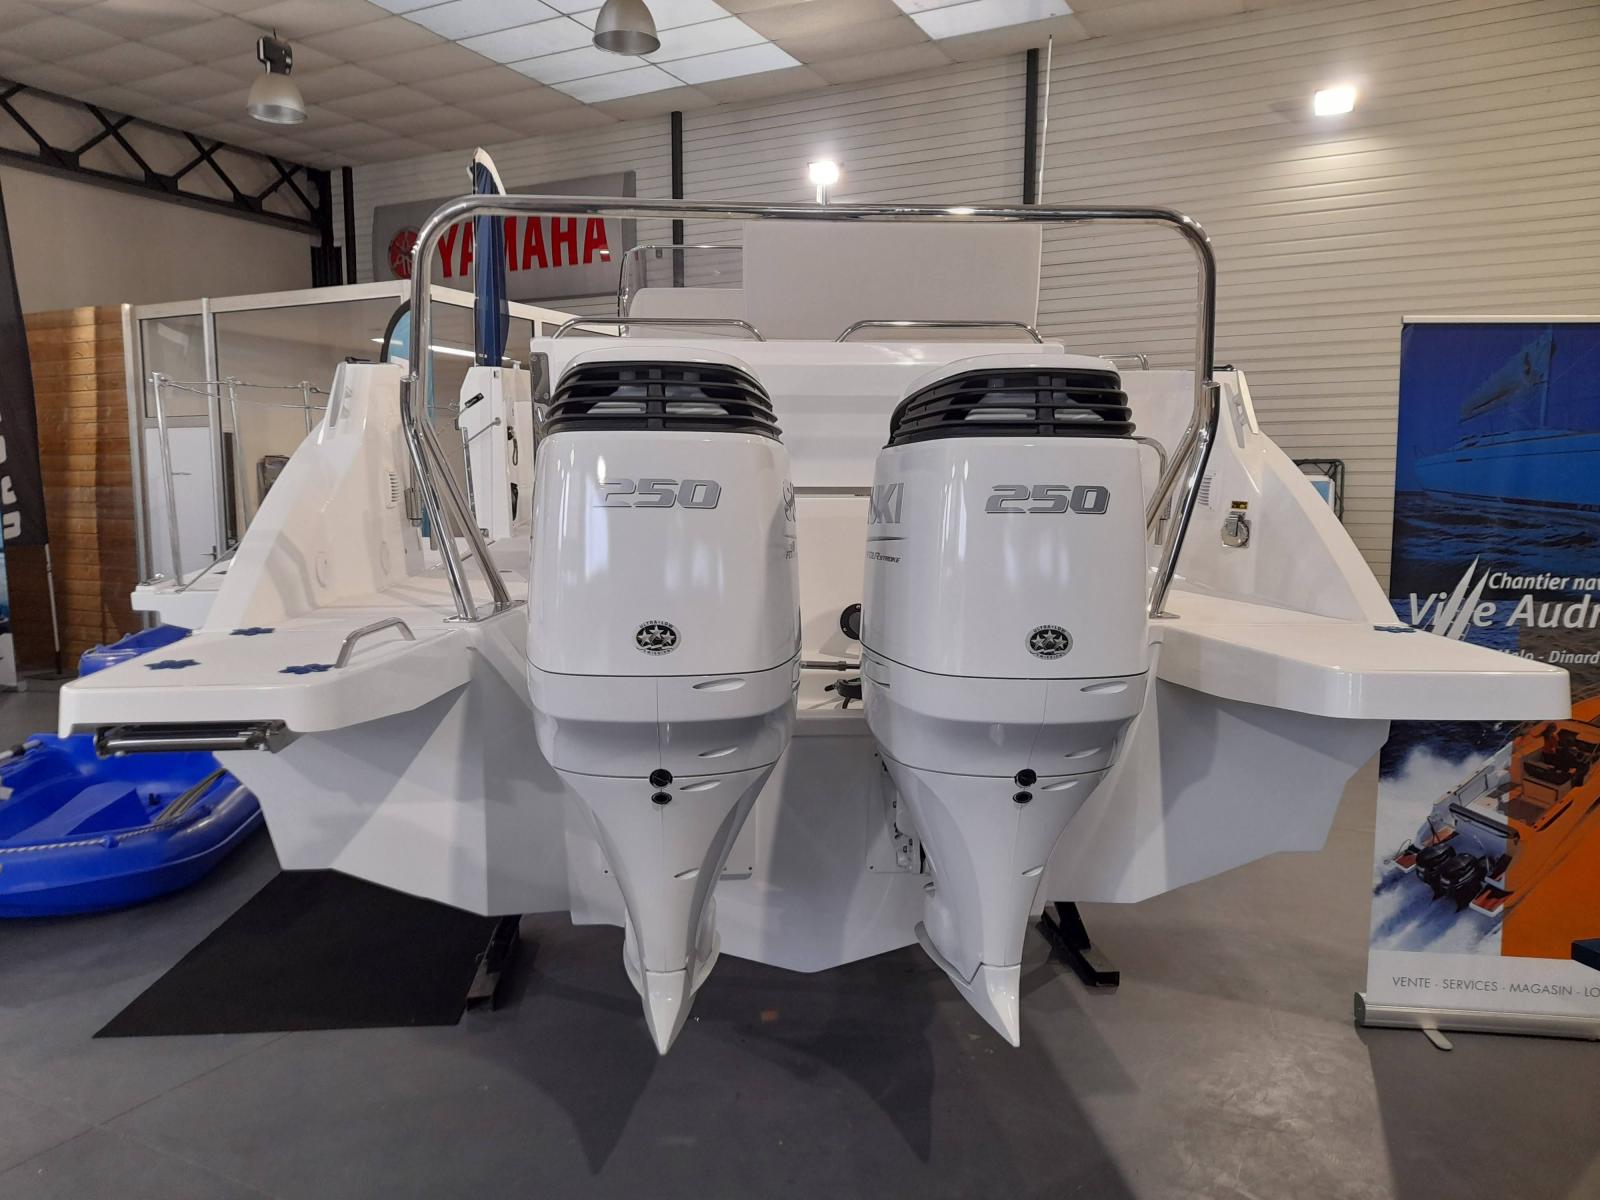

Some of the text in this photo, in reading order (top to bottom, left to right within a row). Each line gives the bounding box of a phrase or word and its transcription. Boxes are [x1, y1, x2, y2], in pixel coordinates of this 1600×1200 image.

[593, 478, 721, 509] 250
[985, 484, 1110, 515] 250
[1488, 572, 1571, 590] Chantier
[1549, 649, 1600, 665] Dinard
[1392, 976, 1432, 989] VENTE
[1441, 978, 1498, 992] SERVICES
[1509, 983, 1573, 996] MAGASIN
